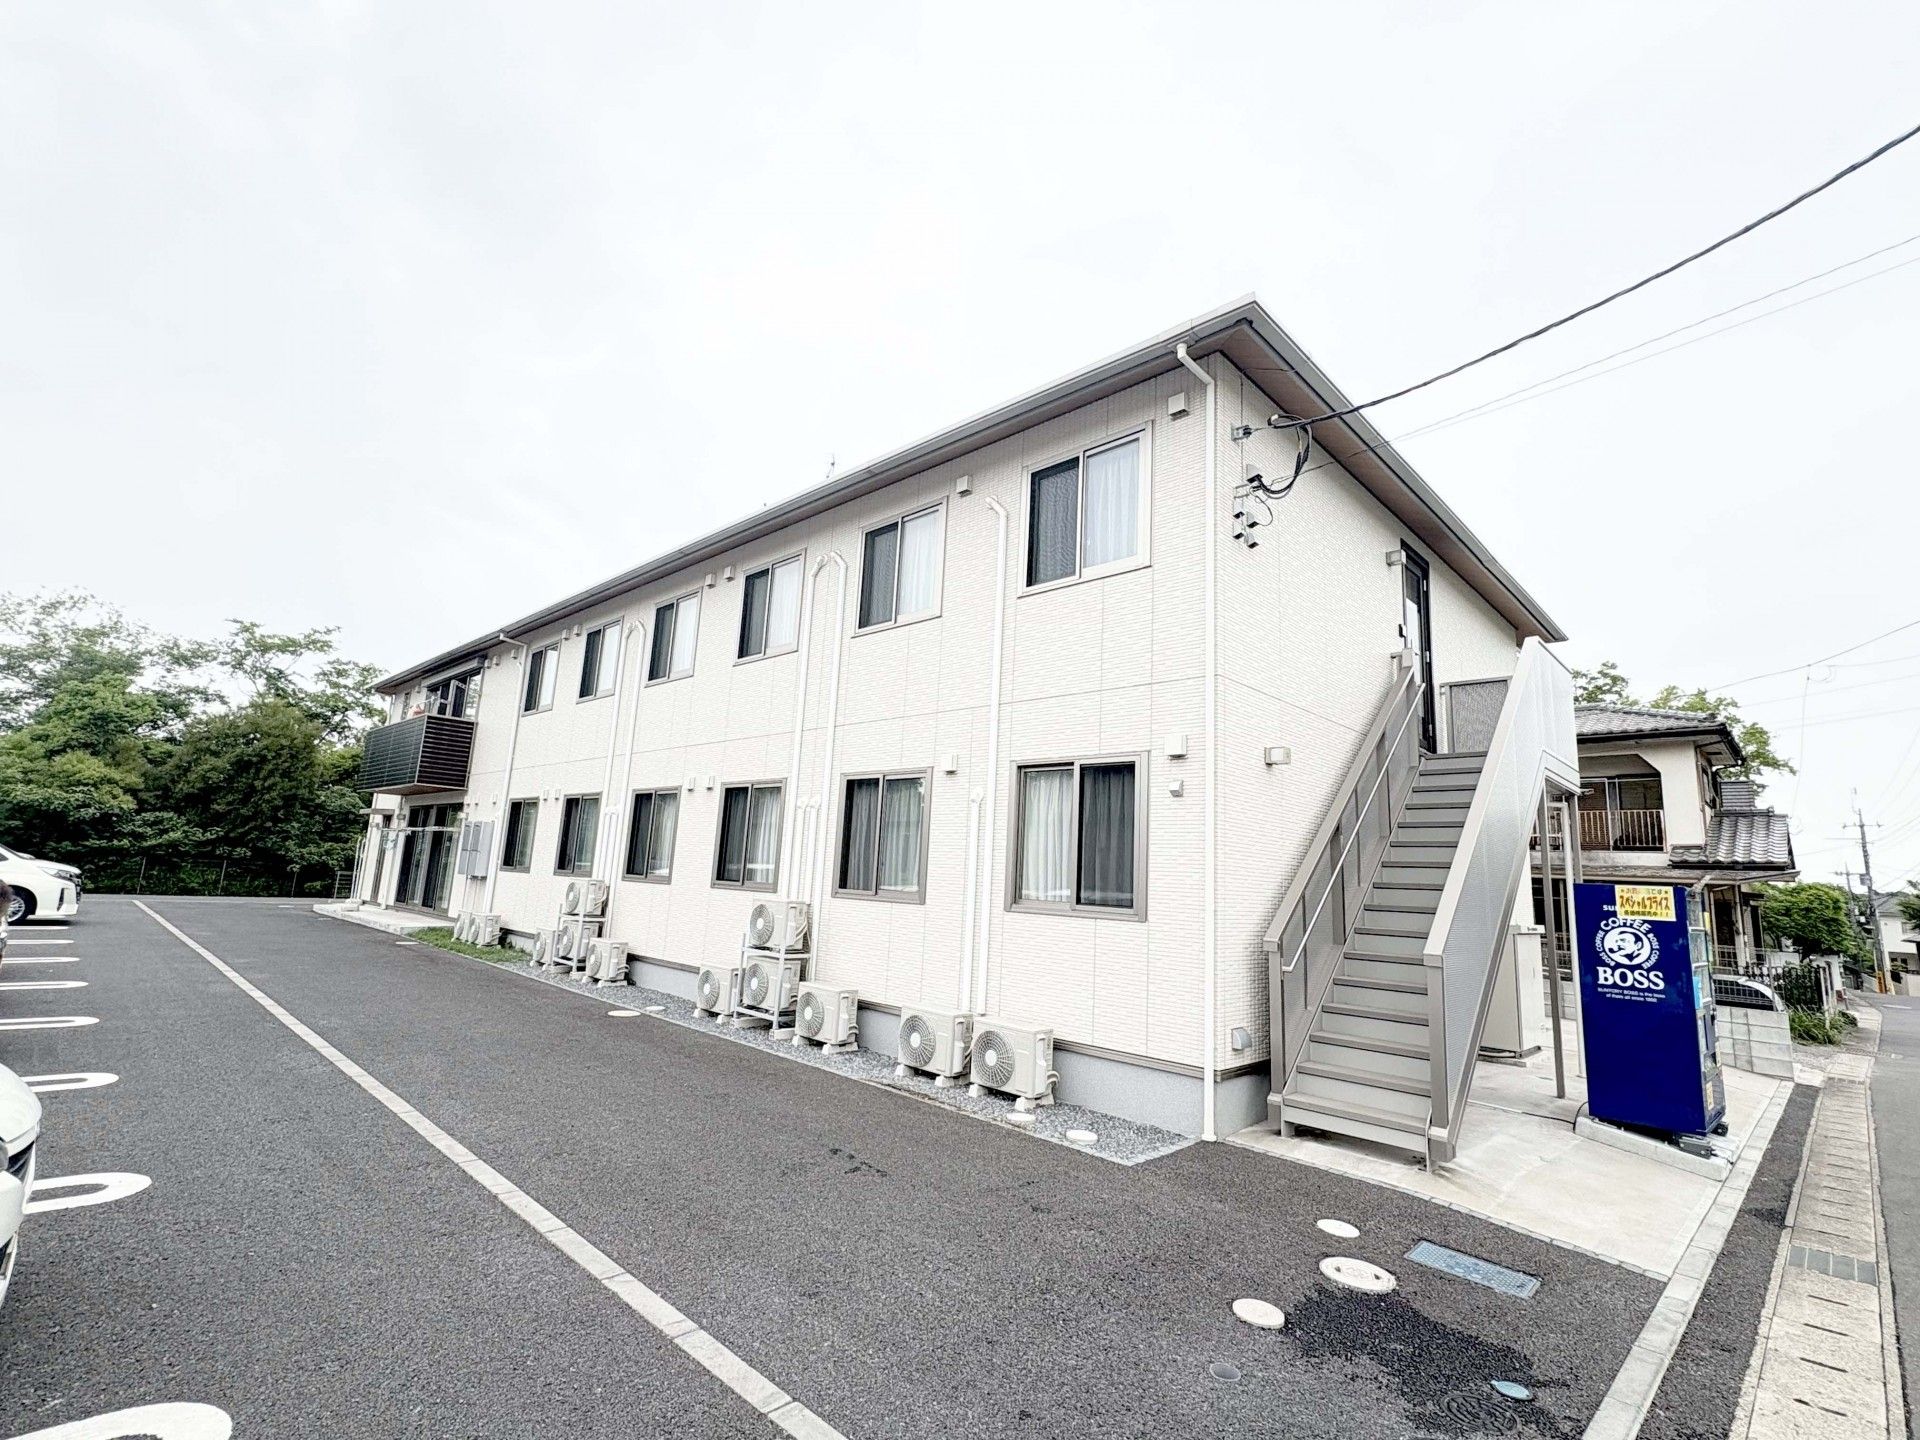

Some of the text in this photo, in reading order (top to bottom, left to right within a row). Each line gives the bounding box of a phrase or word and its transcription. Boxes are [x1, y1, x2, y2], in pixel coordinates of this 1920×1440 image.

[1600, 917, 1652, 933] COFFEE
[1595, 930, 1616, 966] BOSS COFFEE
[1641, 933, 1659, 969] BOSS COFFEE
[1596, 966, 1665, 990] BOSS
